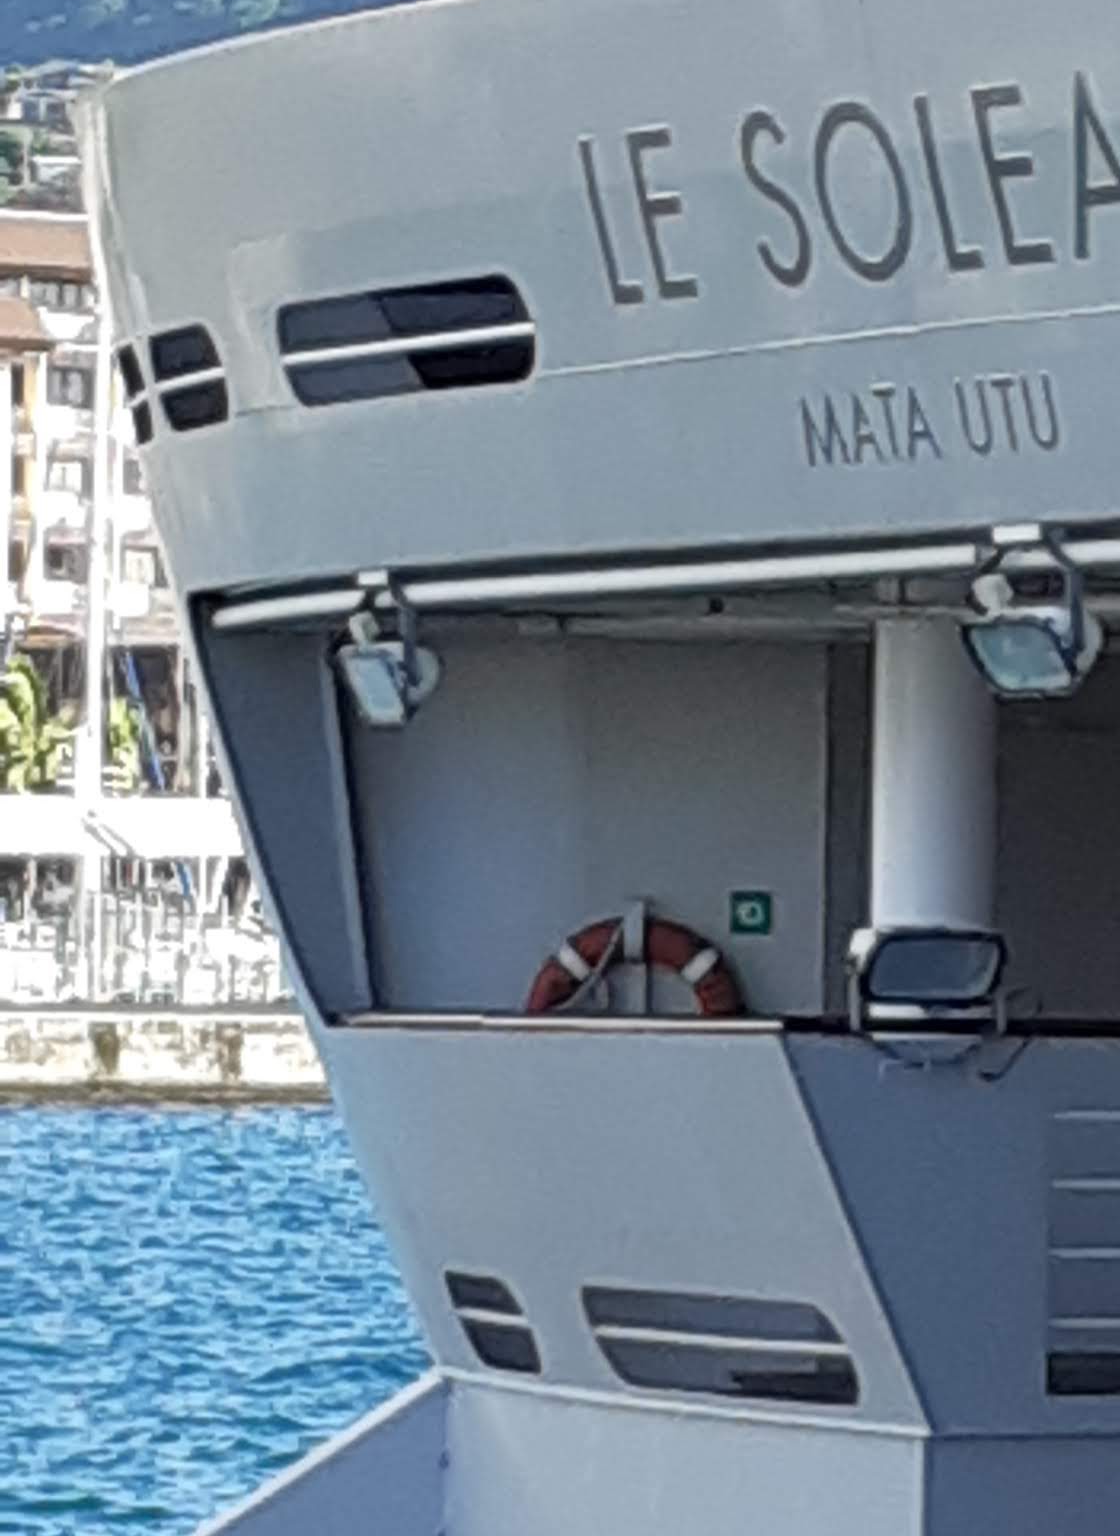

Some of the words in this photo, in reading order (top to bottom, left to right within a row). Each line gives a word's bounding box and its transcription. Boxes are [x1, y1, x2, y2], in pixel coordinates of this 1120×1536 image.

[577, 126, 699, 305] LE
[800, 382, 942, 467] MATA
[953, 373, 1060, 453] UTU
